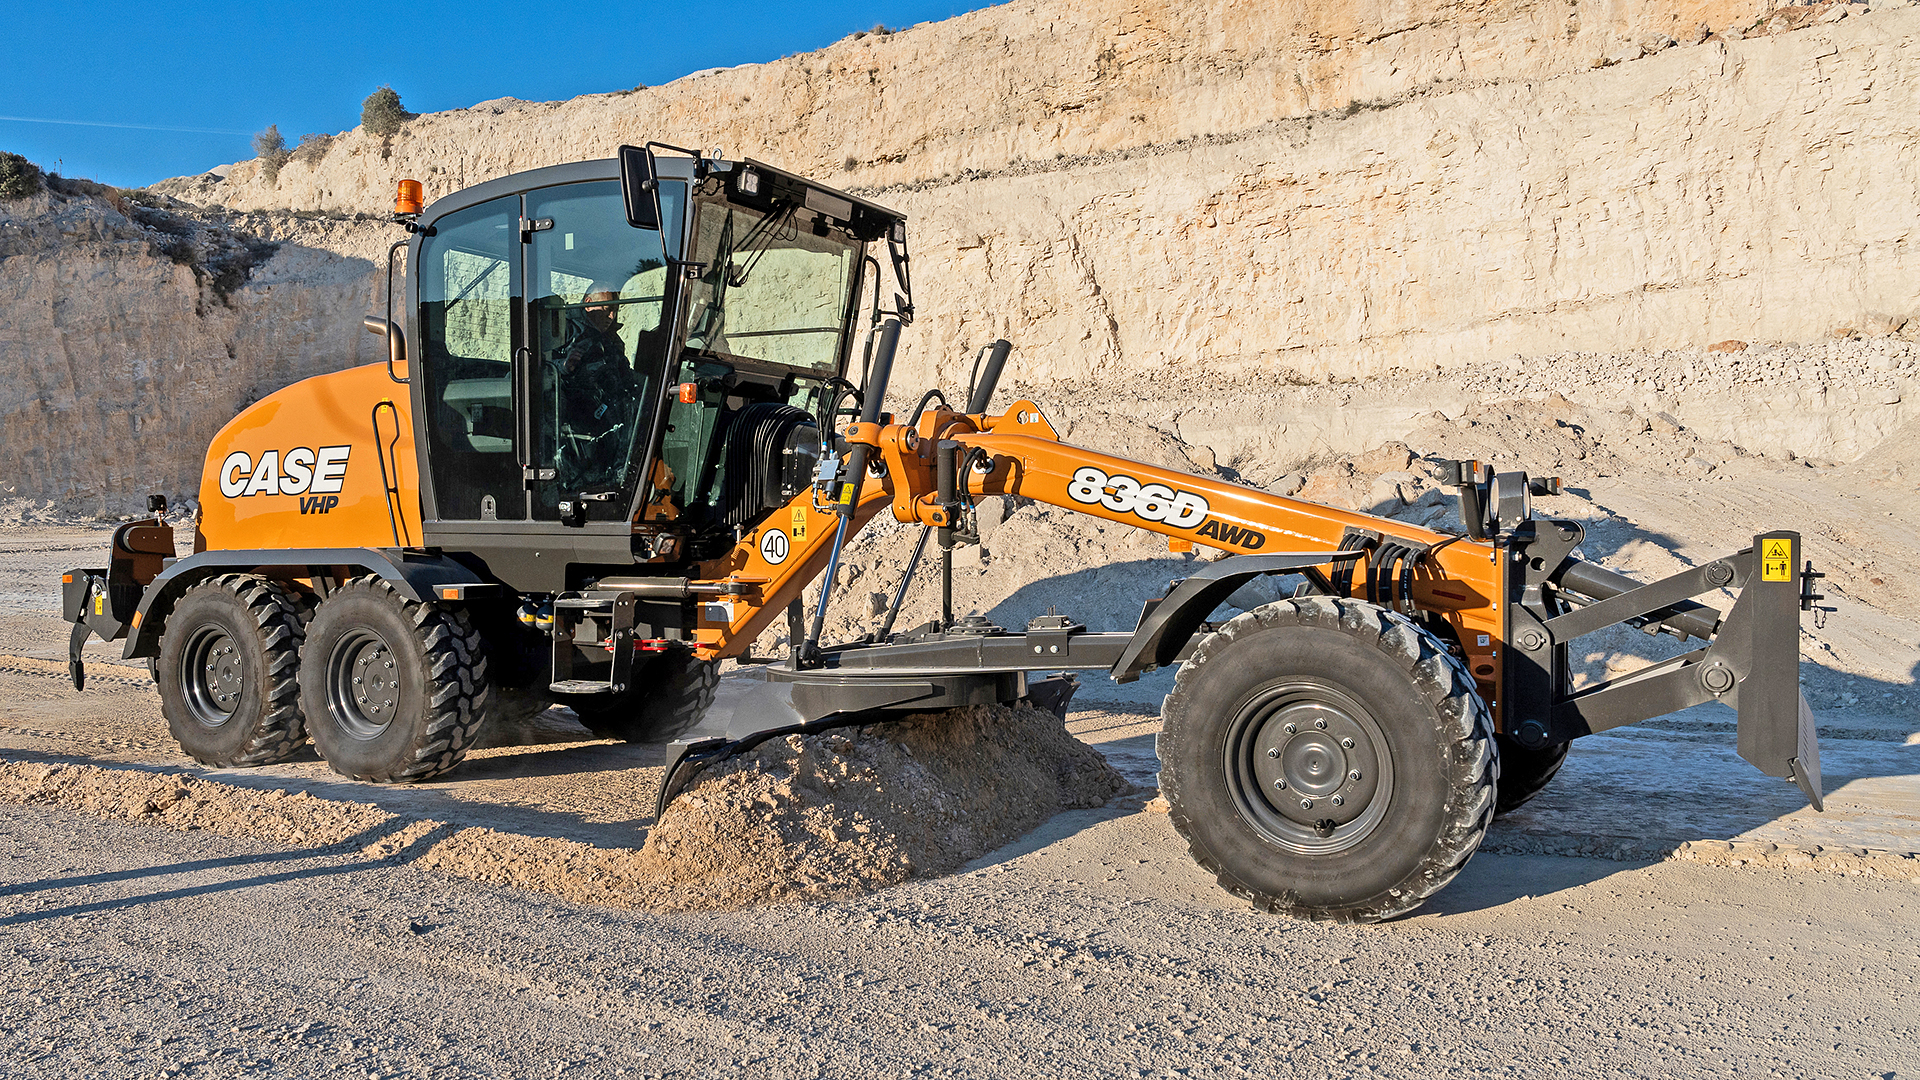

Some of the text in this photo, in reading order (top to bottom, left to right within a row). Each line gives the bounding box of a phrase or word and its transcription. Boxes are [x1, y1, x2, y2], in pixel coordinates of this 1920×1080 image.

[219, 445, 352, 499] CASE
[300, 496, 339, 515] VHP
[1067, 466, 1266, 550] 836D AWD
[764, 535, 786, 558] 40
